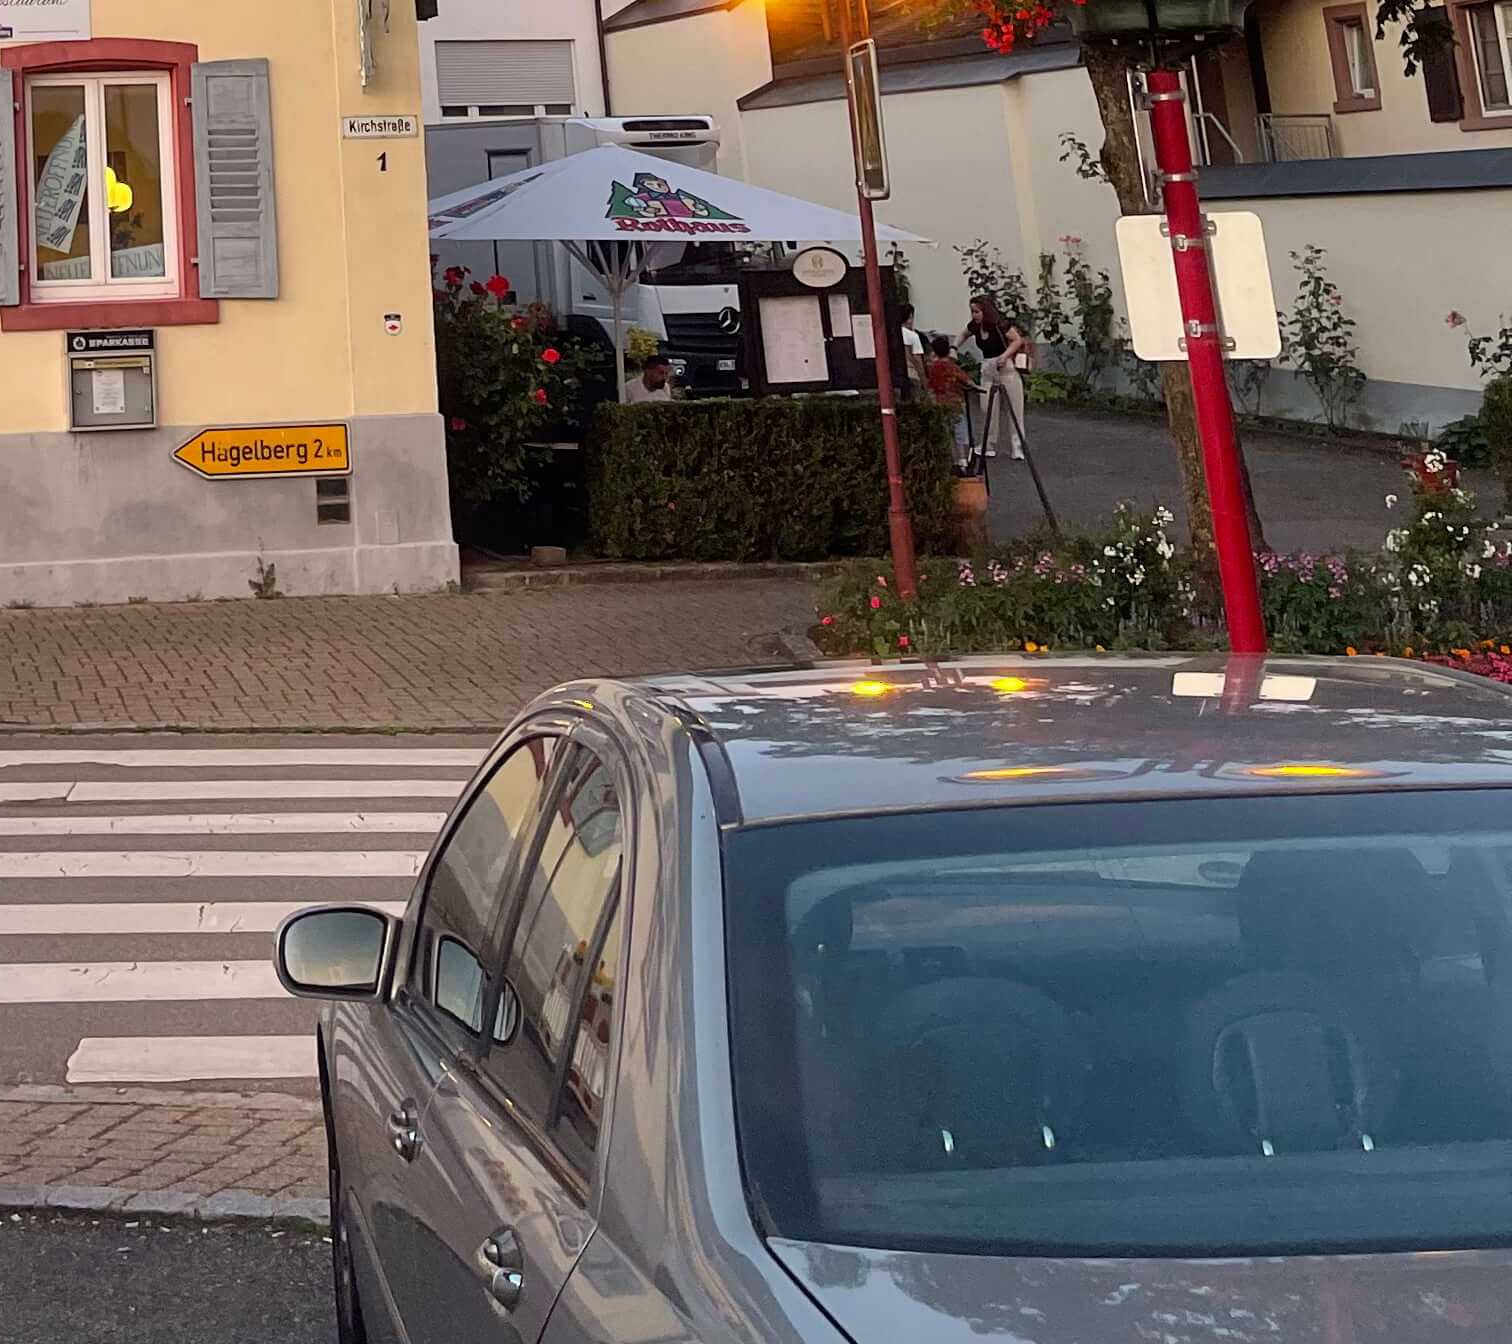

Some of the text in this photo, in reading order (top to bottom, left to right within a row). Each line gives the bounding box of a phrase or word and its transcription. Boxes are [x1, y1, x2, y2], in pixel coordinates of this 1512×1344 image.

[349, 118, 411, 133] Kirchstraße
[376, 151, 388, 172] 1
[611, 216, 752, 236] Rothaus
[88, 337, 150, 348] SPARKASSE
[312, 439, 324, 459] 2
[326, 446, 342, 458] km
